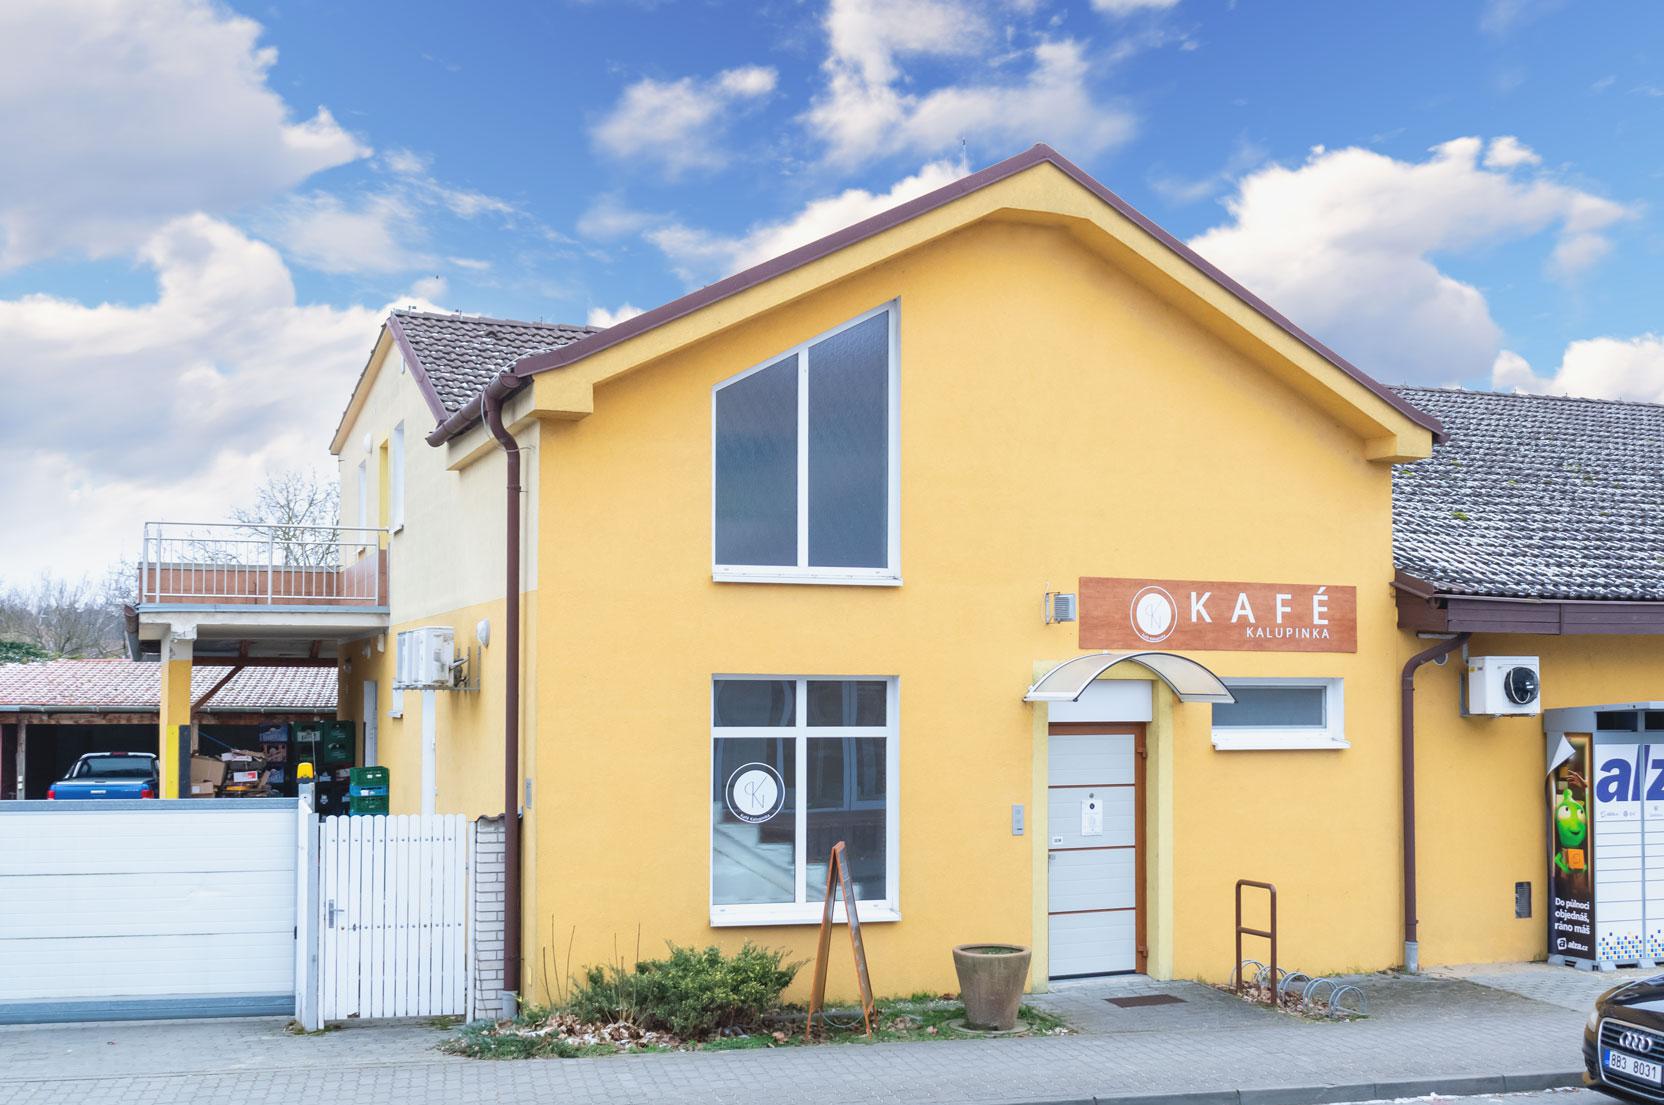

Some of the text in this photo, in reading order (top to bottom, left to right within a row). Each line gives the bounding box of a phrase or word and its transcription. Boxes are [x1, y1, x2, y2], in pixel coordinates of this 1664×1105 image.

[1190, 587, 1329, 625] KAFÉ
[1246, 626, 1330, 639] KALUPINKA
[1555, 897, 1565, 906] Do
[1554, 921, 1573, 931] ráno
[1633, 1061, 1656, 1079] 8031
